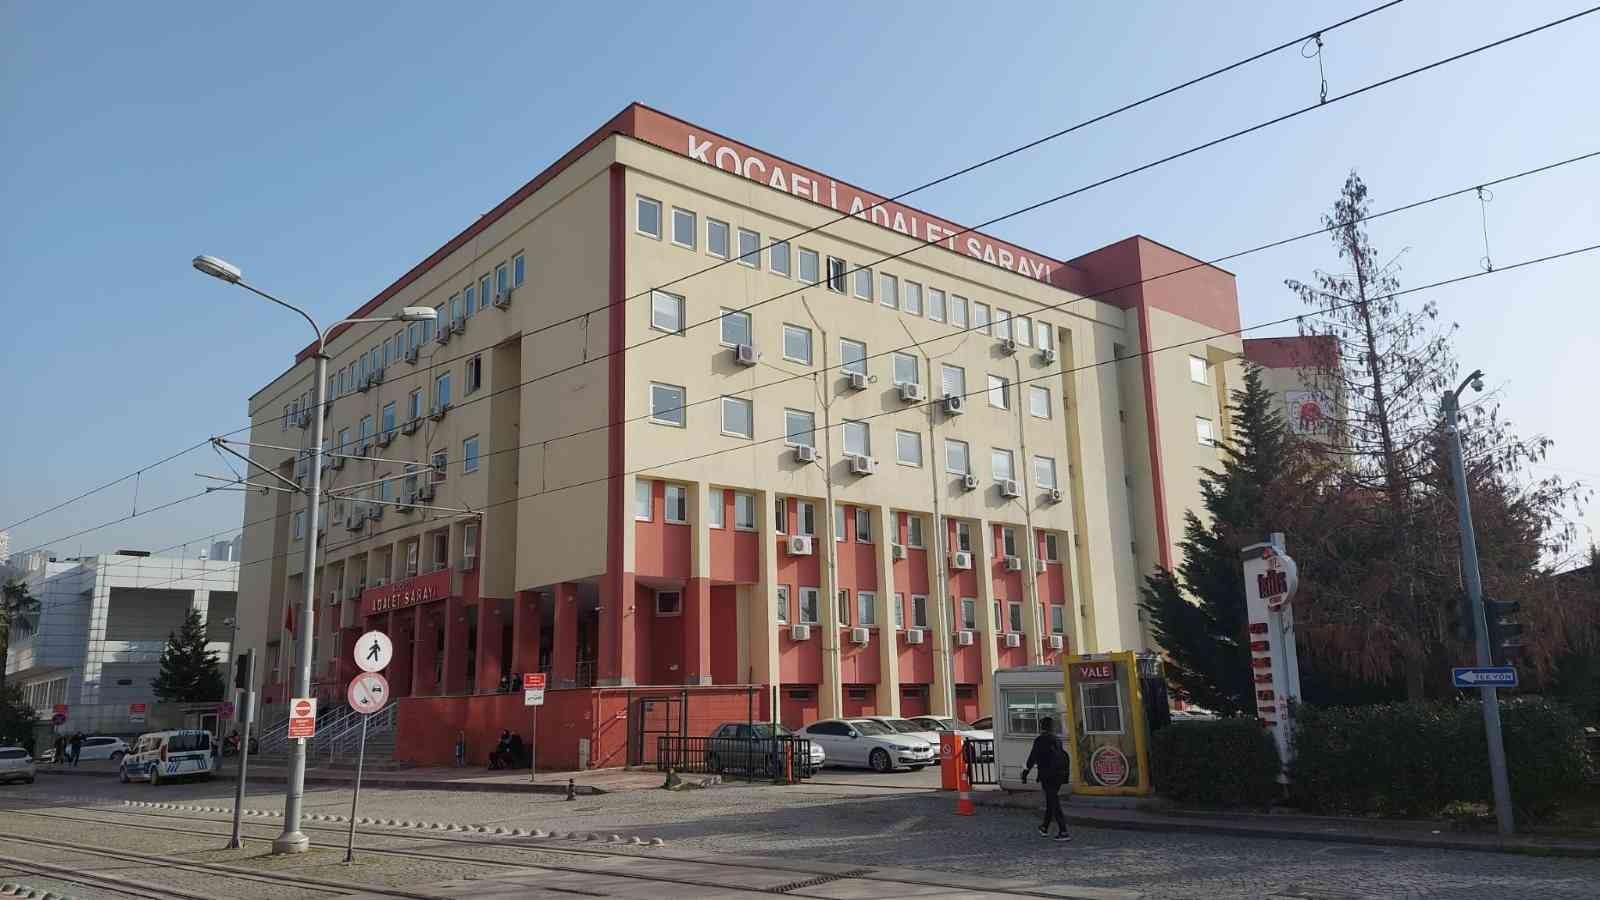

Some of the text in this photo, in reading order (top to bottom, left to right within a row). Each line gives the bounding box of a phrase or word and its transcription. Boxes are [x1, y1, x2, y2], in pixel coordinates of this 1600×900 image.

[848, 194, 961, 251] ADALET
[966, 236, 1053, 283] SARAYI
[1081, 664, 1111, 678] VALE
